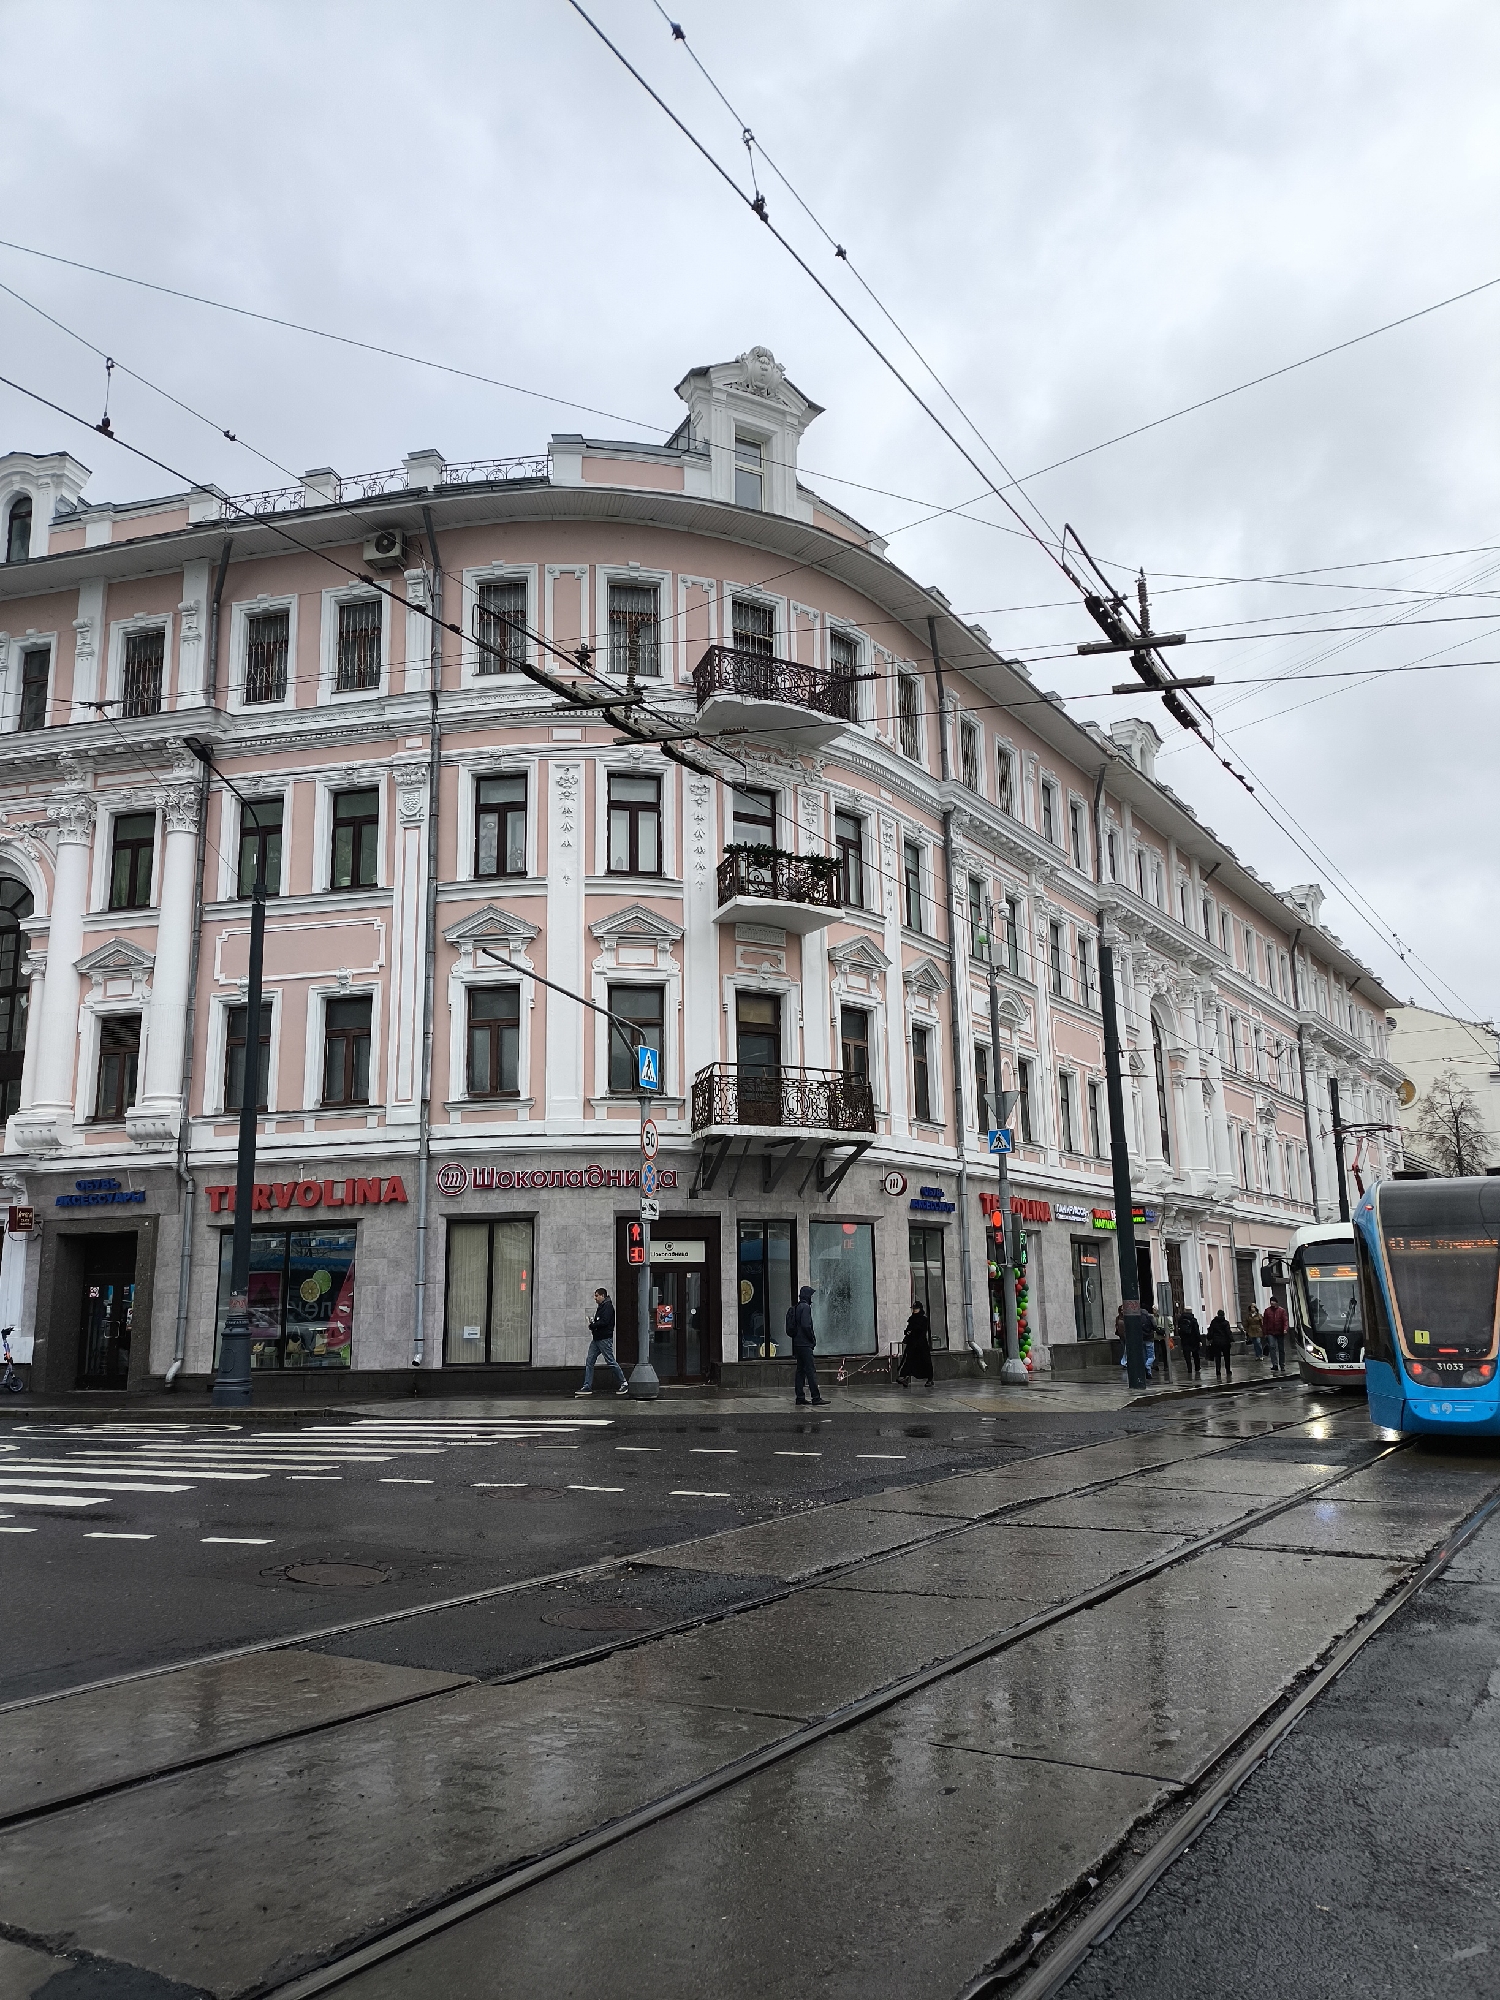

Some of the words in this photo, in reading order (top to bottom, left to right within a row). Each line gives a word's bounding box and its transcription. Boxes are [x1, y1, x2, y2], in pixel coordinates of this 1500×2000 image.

[645, 1130, 656, 1148] 50
[75, 1177, 121, 1192] ОБУВЬ
[472, 1163, 678, 1191] Шоколадниа
[55, 1190, 146, 1206] АКСЕССУАРЫ
[1436, 1362, 1464, 1371] 31033
